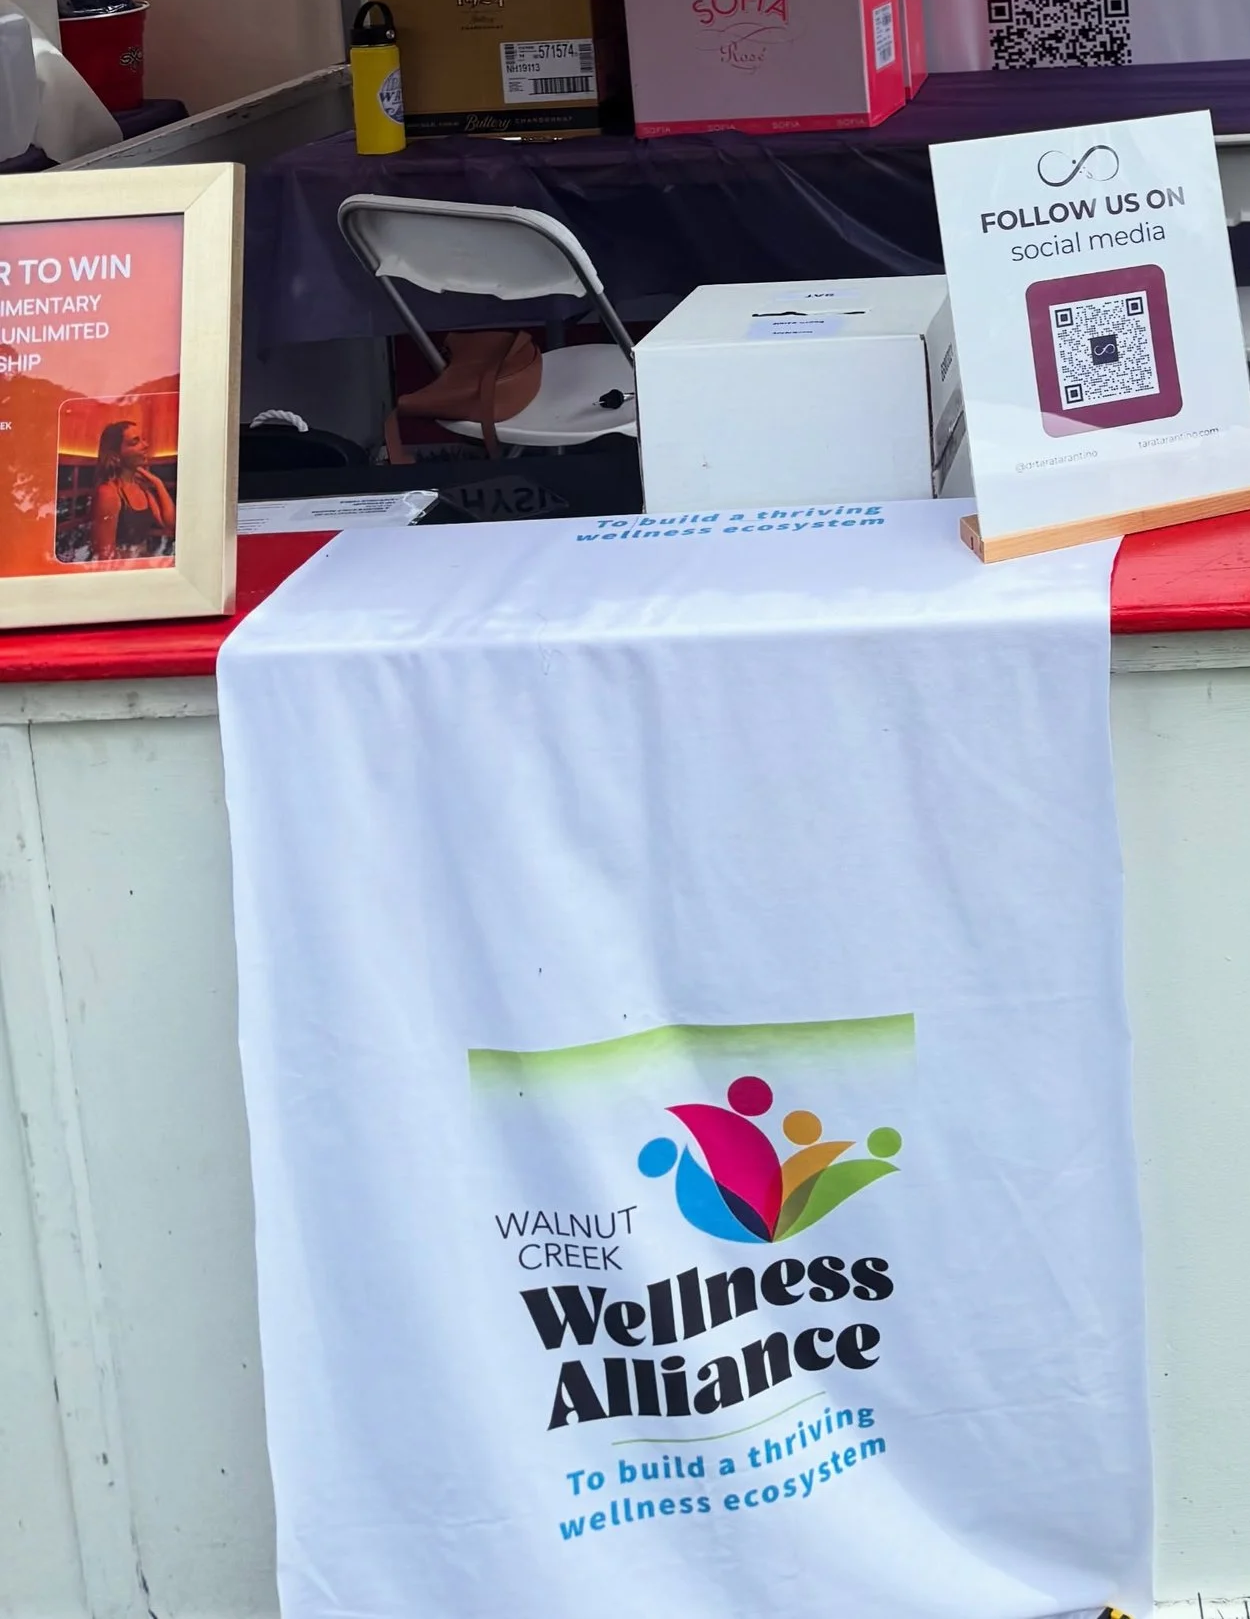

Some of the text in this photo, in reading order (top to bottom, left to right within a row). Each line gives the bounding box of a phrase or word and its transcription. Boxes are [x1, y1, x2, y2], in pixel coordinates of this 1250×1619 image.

[506, 63, 540, 73] NH19113
[538, 44, 574, 59] 571574
[720, 40, 766, 64] Rosé
[980, 186, 1186, 234] FOLLOW US ON
[1011, 221, 1166, 262] social media
[18, 257, 62, 285] TO
[69, 253, 132, 281] WIN
[0, 294, 102, 316] IMENTARY
[1, 321, 110, 345] UNLIMITED
[494, 1205, 638, 1240] WALNUT
[518, 1243, 624, 1272] CREEK
[519, 1254, 895, 1351] Wellness
[546, 1322, 882, 1432] Alliance
[566, 1404, 877, 1497] To build a thriving
[558, 1432, 887, 1541] wellness ecosystem
